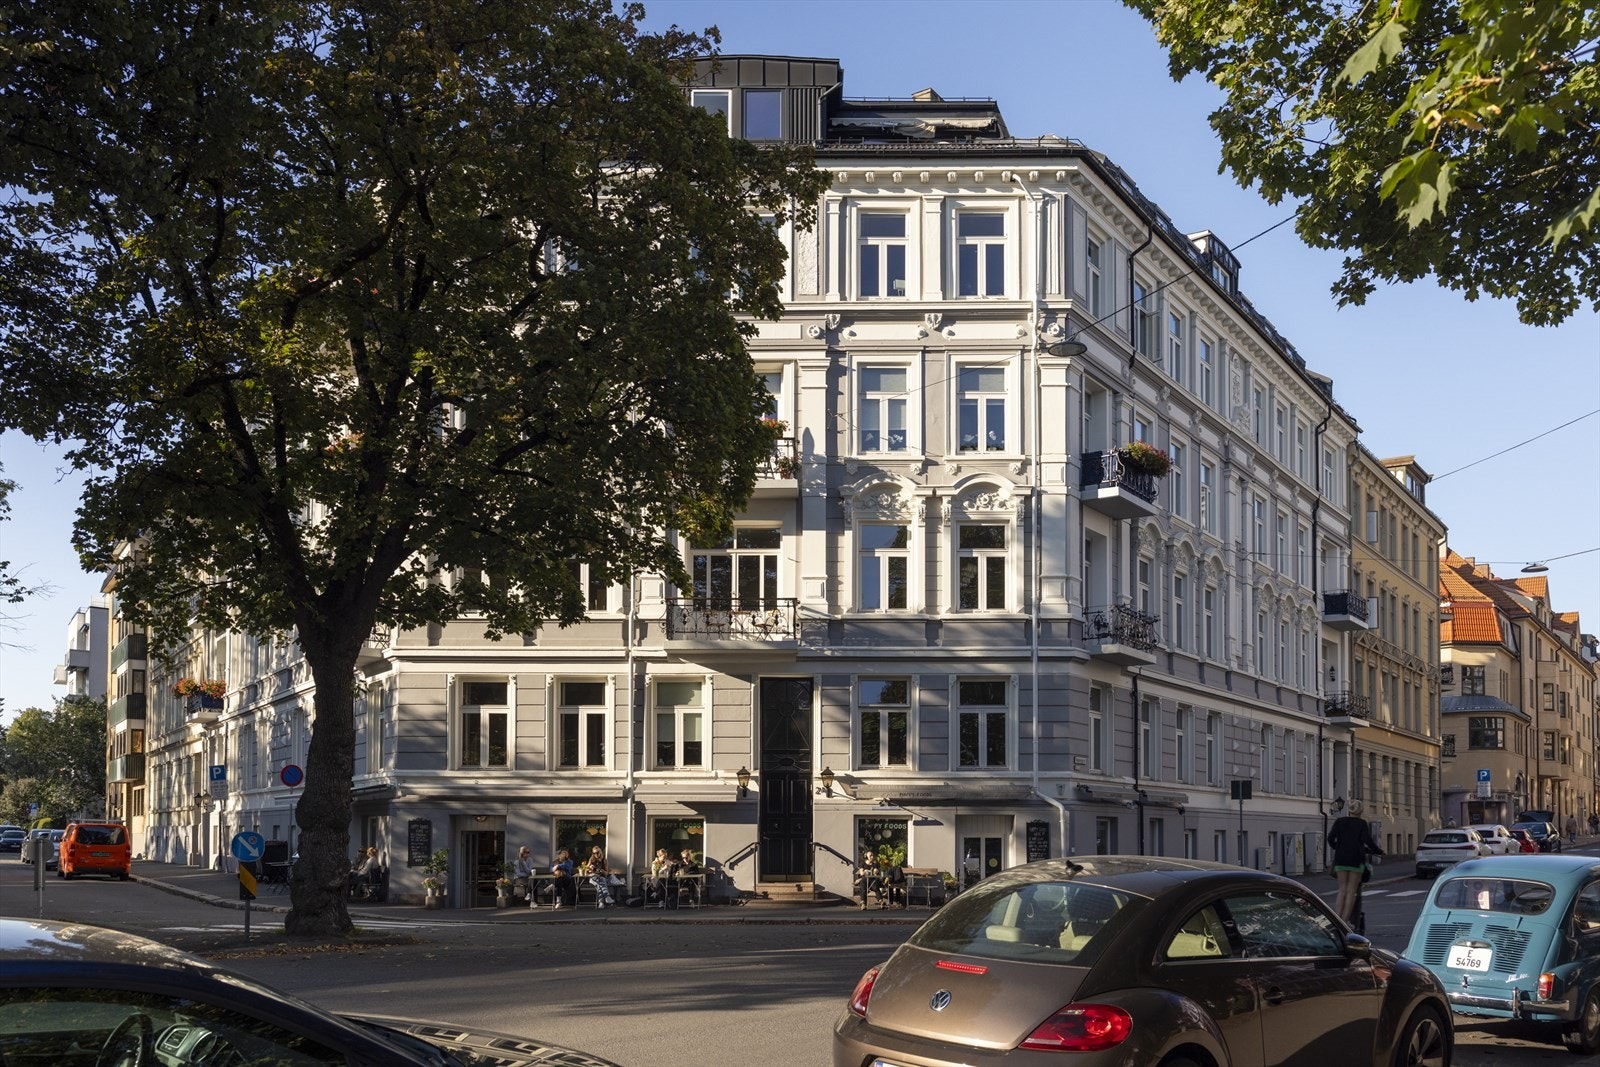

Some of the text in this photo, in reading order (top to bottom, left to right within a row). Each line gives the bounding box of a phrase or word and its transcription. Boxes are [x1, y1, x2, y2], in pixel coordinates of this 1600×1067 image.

[212, 767, 221, 779] P
[1479, 770, 1488, 780] P
[1467, 949, 1474, 958] E
[1456, 957, 1482, 968] 54769
